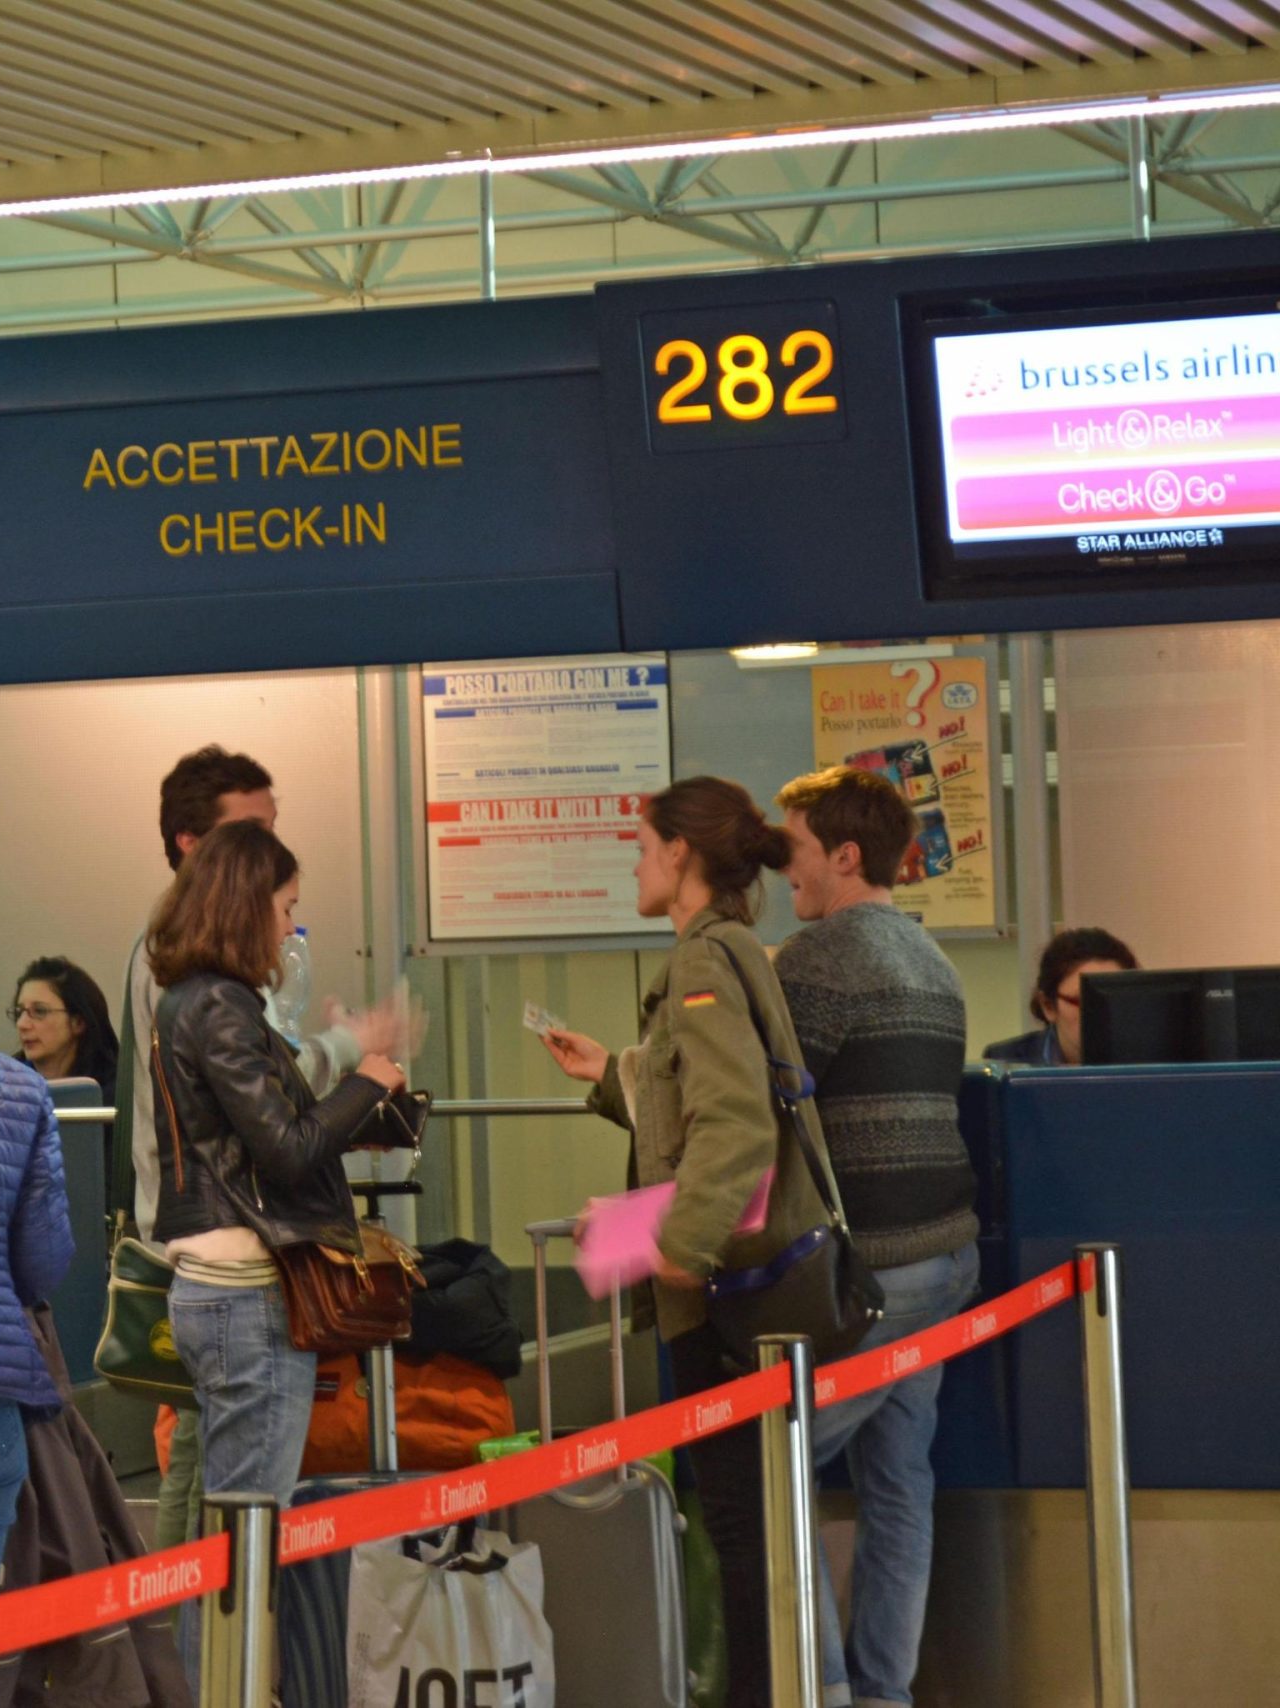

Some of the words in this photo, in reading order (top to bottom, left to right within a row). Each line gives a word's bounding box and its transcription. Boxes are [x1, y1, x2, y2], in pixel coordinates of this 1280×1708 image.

[655, 330, 838, 423] 282
[1020, 351, 1169, 390] brussels
[1183, 344, 1276, 379] airlin
[1052, 418, 1115, 454] Light
[83, 422, 464, 490] ACCETTAZIONE
[1058, 478, 1143, 513] Check
[159, 501, 388, 557] CHECK-IN
[1077, 534, 1120, 553] STAR
[1124, 529, 1207, 550] ALLIANCE
[445, 674, 495, 696] POSSO
[497, 670, 571, 695] PORTARLO
[574, 669, 604, 691] CON
[608, 668, 629, 688] ME
[820, 690, 845, 712] Can
[859, 688, 886, 710] take
[891, 689, 900, 710] it
[821, 716, 854, 732] Posso
[857, 714, 901, 734] portarlo
[461, 802, 490, 822] CAN
[502, 800, 536, 821] TAKE
[539, 799, 553, 819] IT
[557, 797, 596, 818] WITH
[599, 797, 621, 816] ME
[1041, 1277, 1065, 1305] Emirates
[972, 1311, 996, 1340] Emirates
[893, 1345, 921, 1374] Emirates
[696, 1399, 732, 1432] Emirates
[577, 1438, 619, 1474] Emirates
[440, 1478, 487, 1516] Emirates
[281, 1515, 336, 1556] Emirates
[128, 1558, 202, 1608] Emirates
